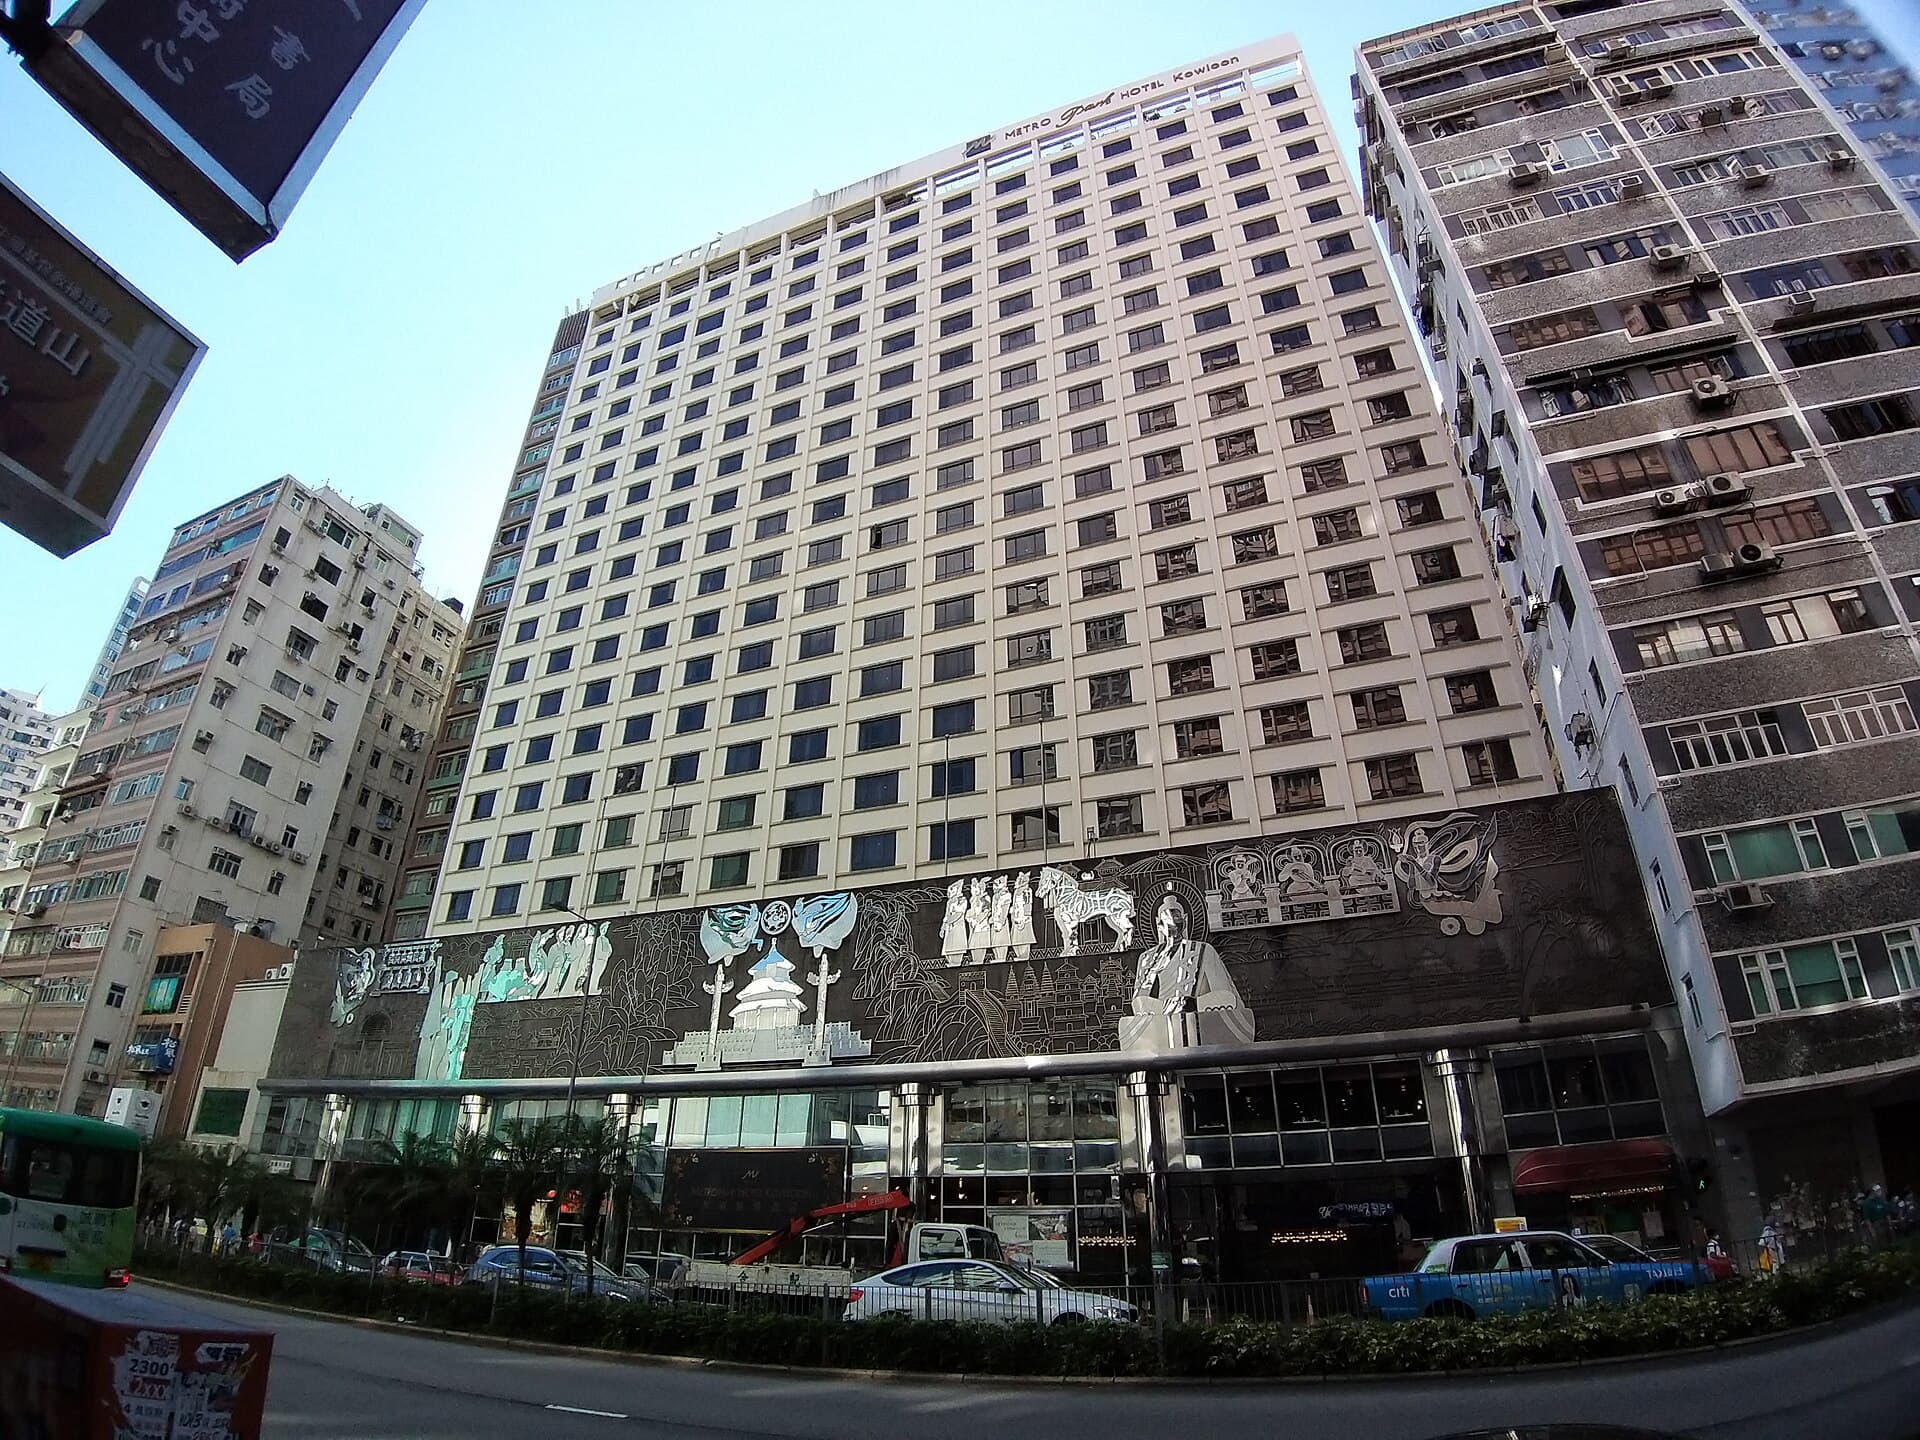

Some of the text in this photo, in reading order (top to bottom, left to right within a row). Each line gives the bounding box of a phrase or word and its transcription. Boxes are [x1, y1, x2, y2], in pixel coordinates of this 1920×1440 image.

[1005, 56, 1239, 139] METRO Park HOTEL Kowloon
[1388, 1285, 1410, 1298] citi
